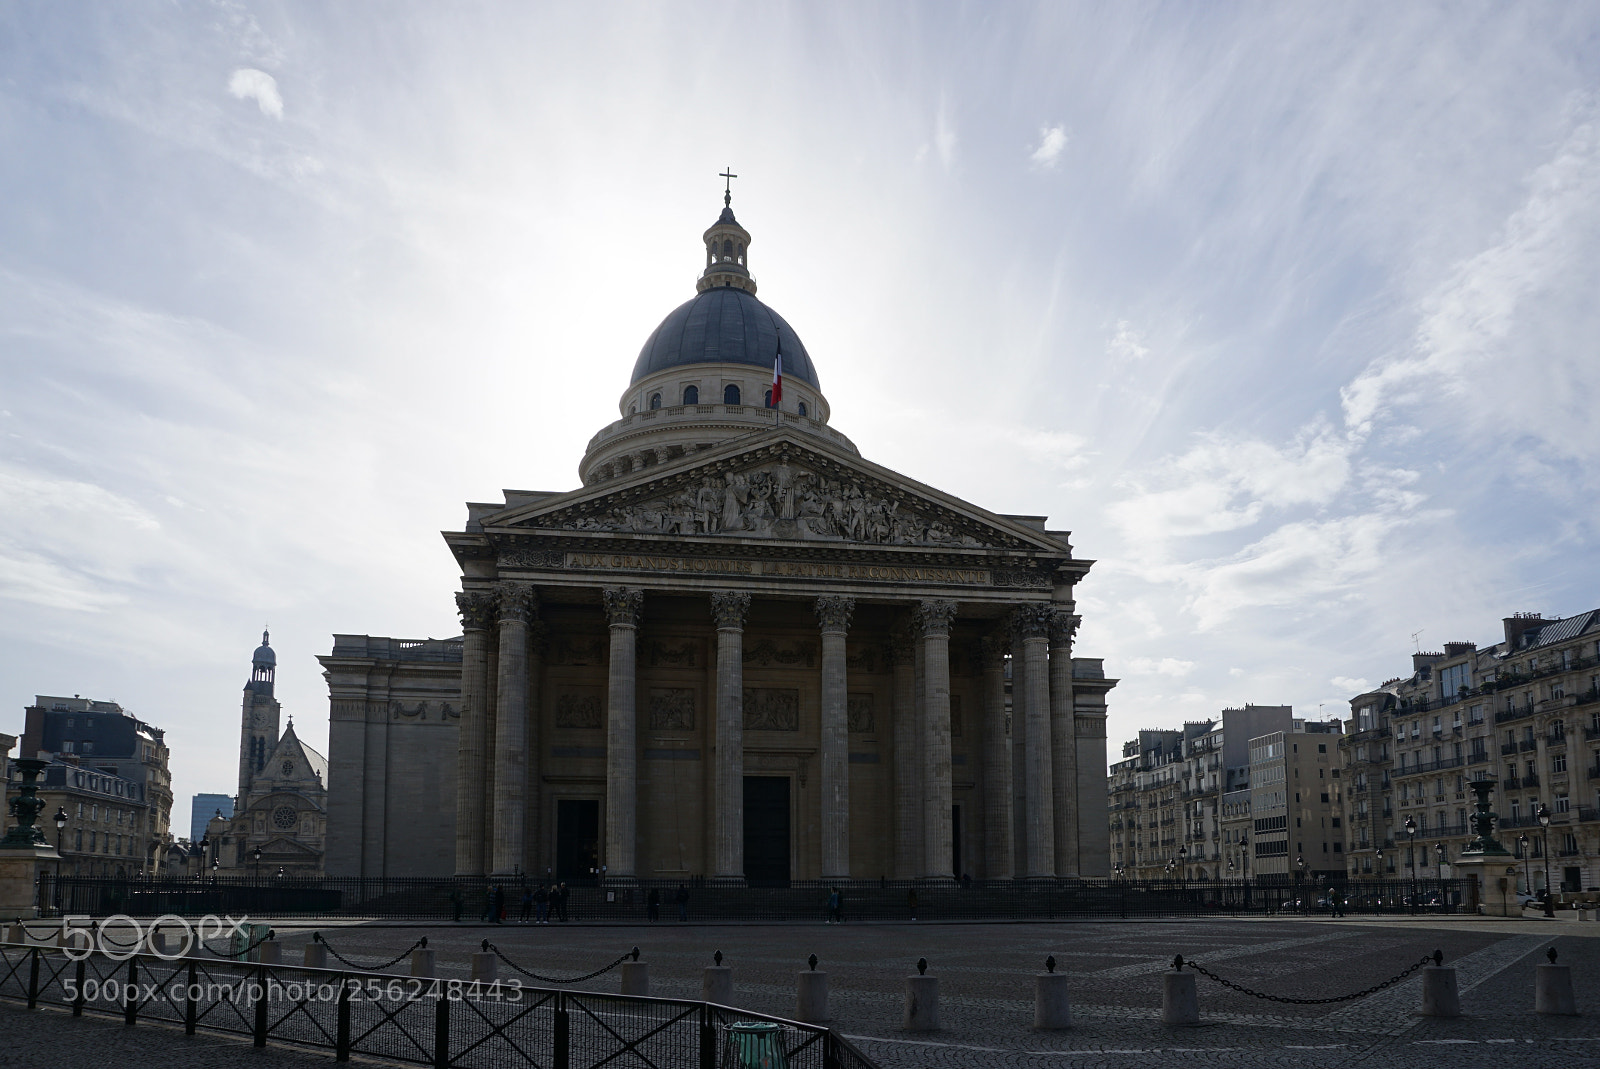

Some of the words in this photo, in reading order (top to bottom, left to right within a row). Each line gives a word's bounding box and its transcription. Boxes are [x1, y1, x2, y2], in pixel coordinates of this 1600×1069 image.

[570, 554, 606, 567] AUX
[611, 555, 678, 570] GRANDS
[682, 558, 752, 573] HOMMES
[762, 562, 780, 575] LA
[787, 563, 843, 577] PATRIE
[848, 565, 986, 583] RECONNAISSANTE
